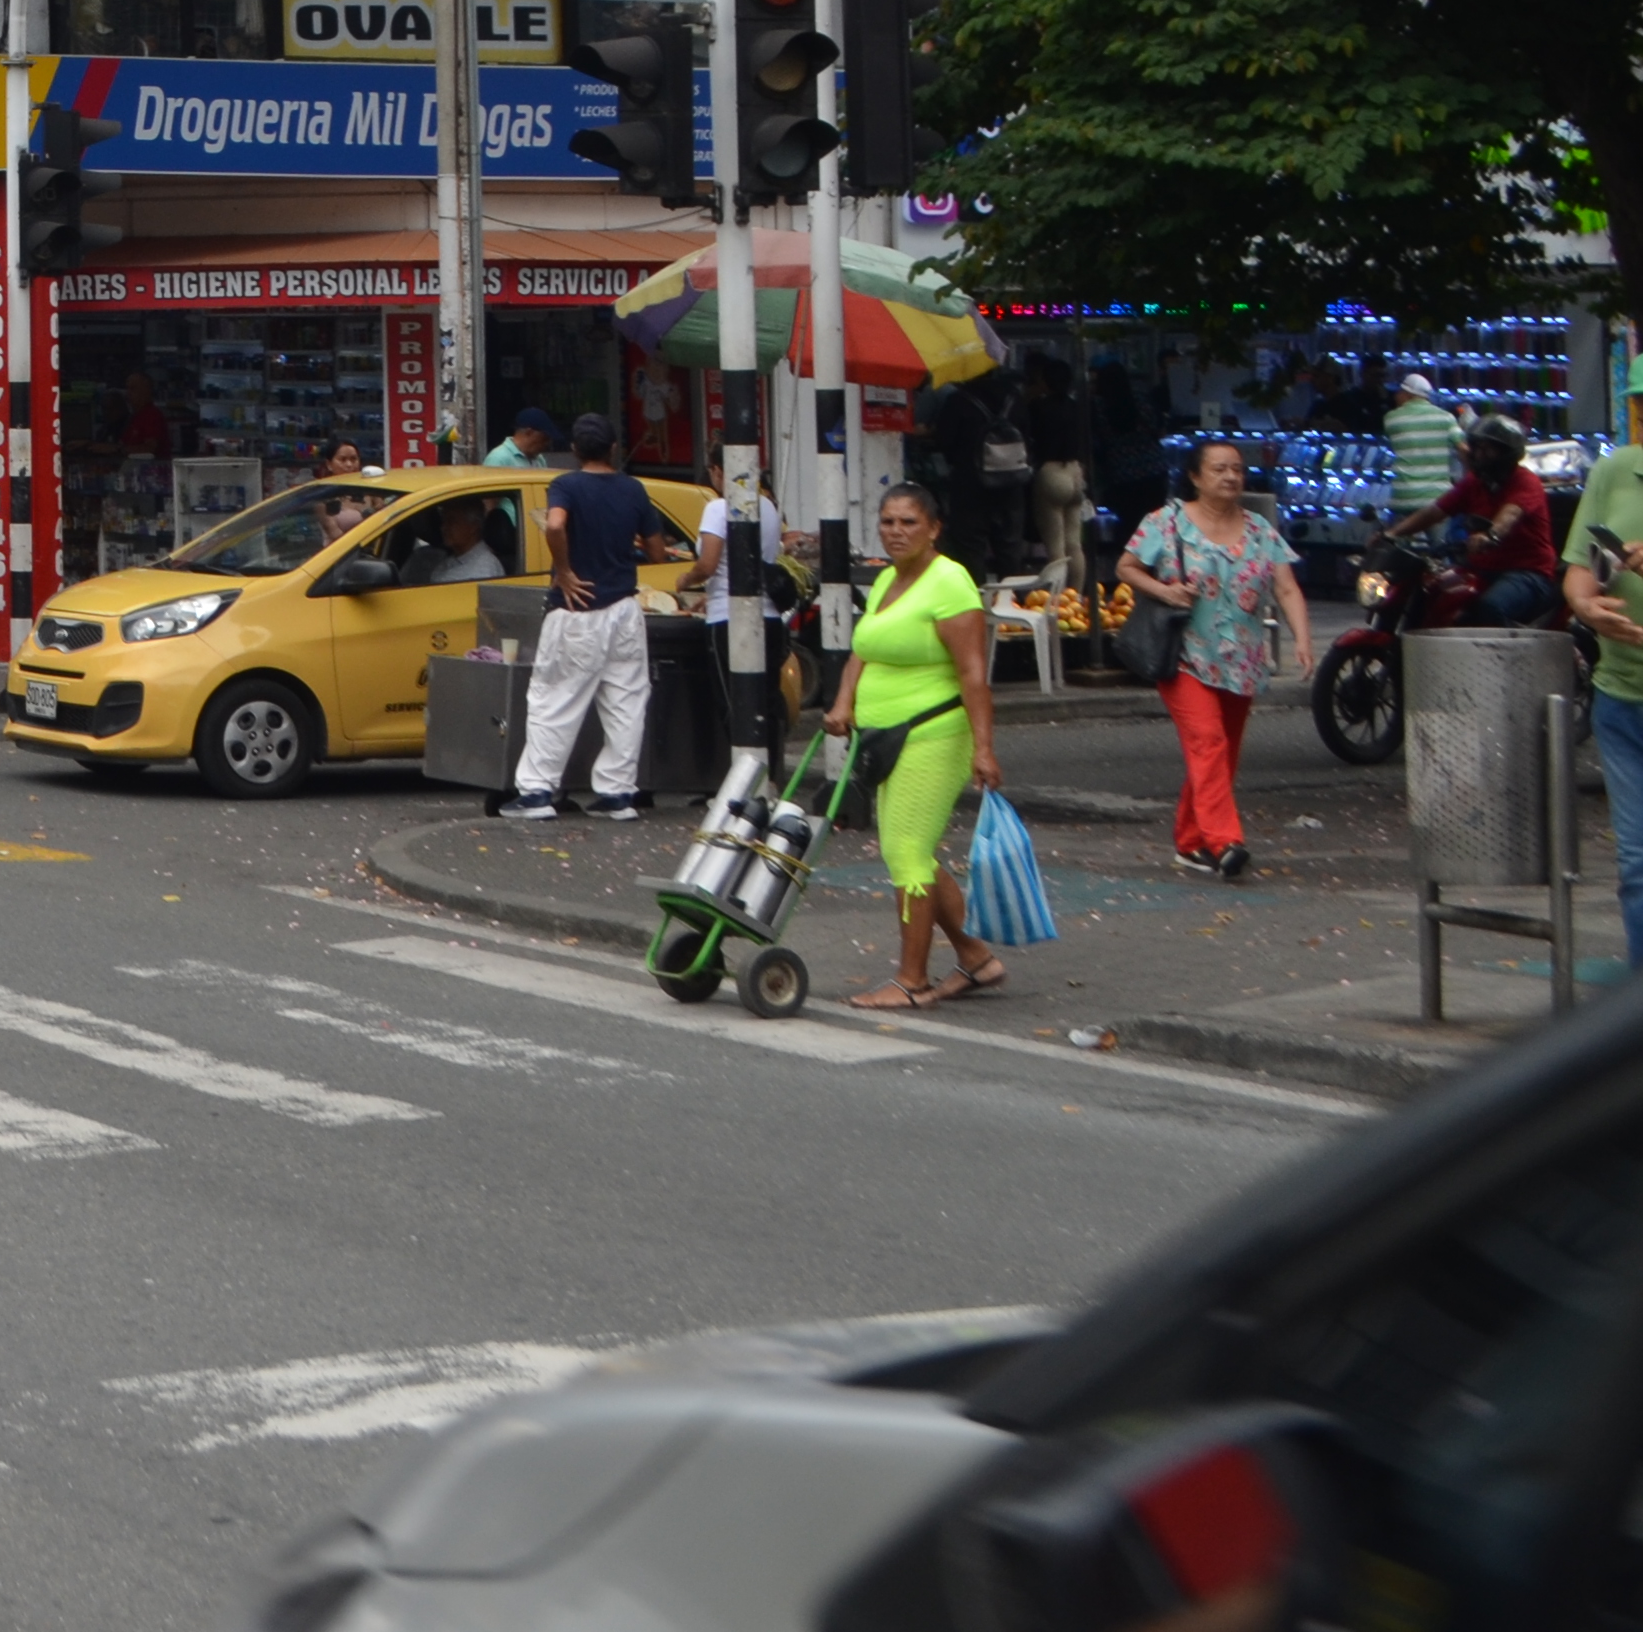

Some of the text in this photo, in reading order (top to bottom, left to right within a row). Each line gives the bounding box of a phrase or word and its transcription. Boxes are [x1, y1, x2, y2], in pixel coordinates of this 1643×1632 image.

[296, 4, 548, 42] OVALE
[580, 84, 618, 96] PRODU
[345, 91, 406, 146] Mil
[419, 93, 553, 157] Dgas
[580, 106, 617, 117] LECHES
[153, 270, 261, 300] HIGIENE
[270, 268, 407, 299] PERSONAL
[517, 267, 628, 296] SERVICIO
[397, 321, 427, 468] PROMOCIO
[385, 701, 426, 713] SERVIC
